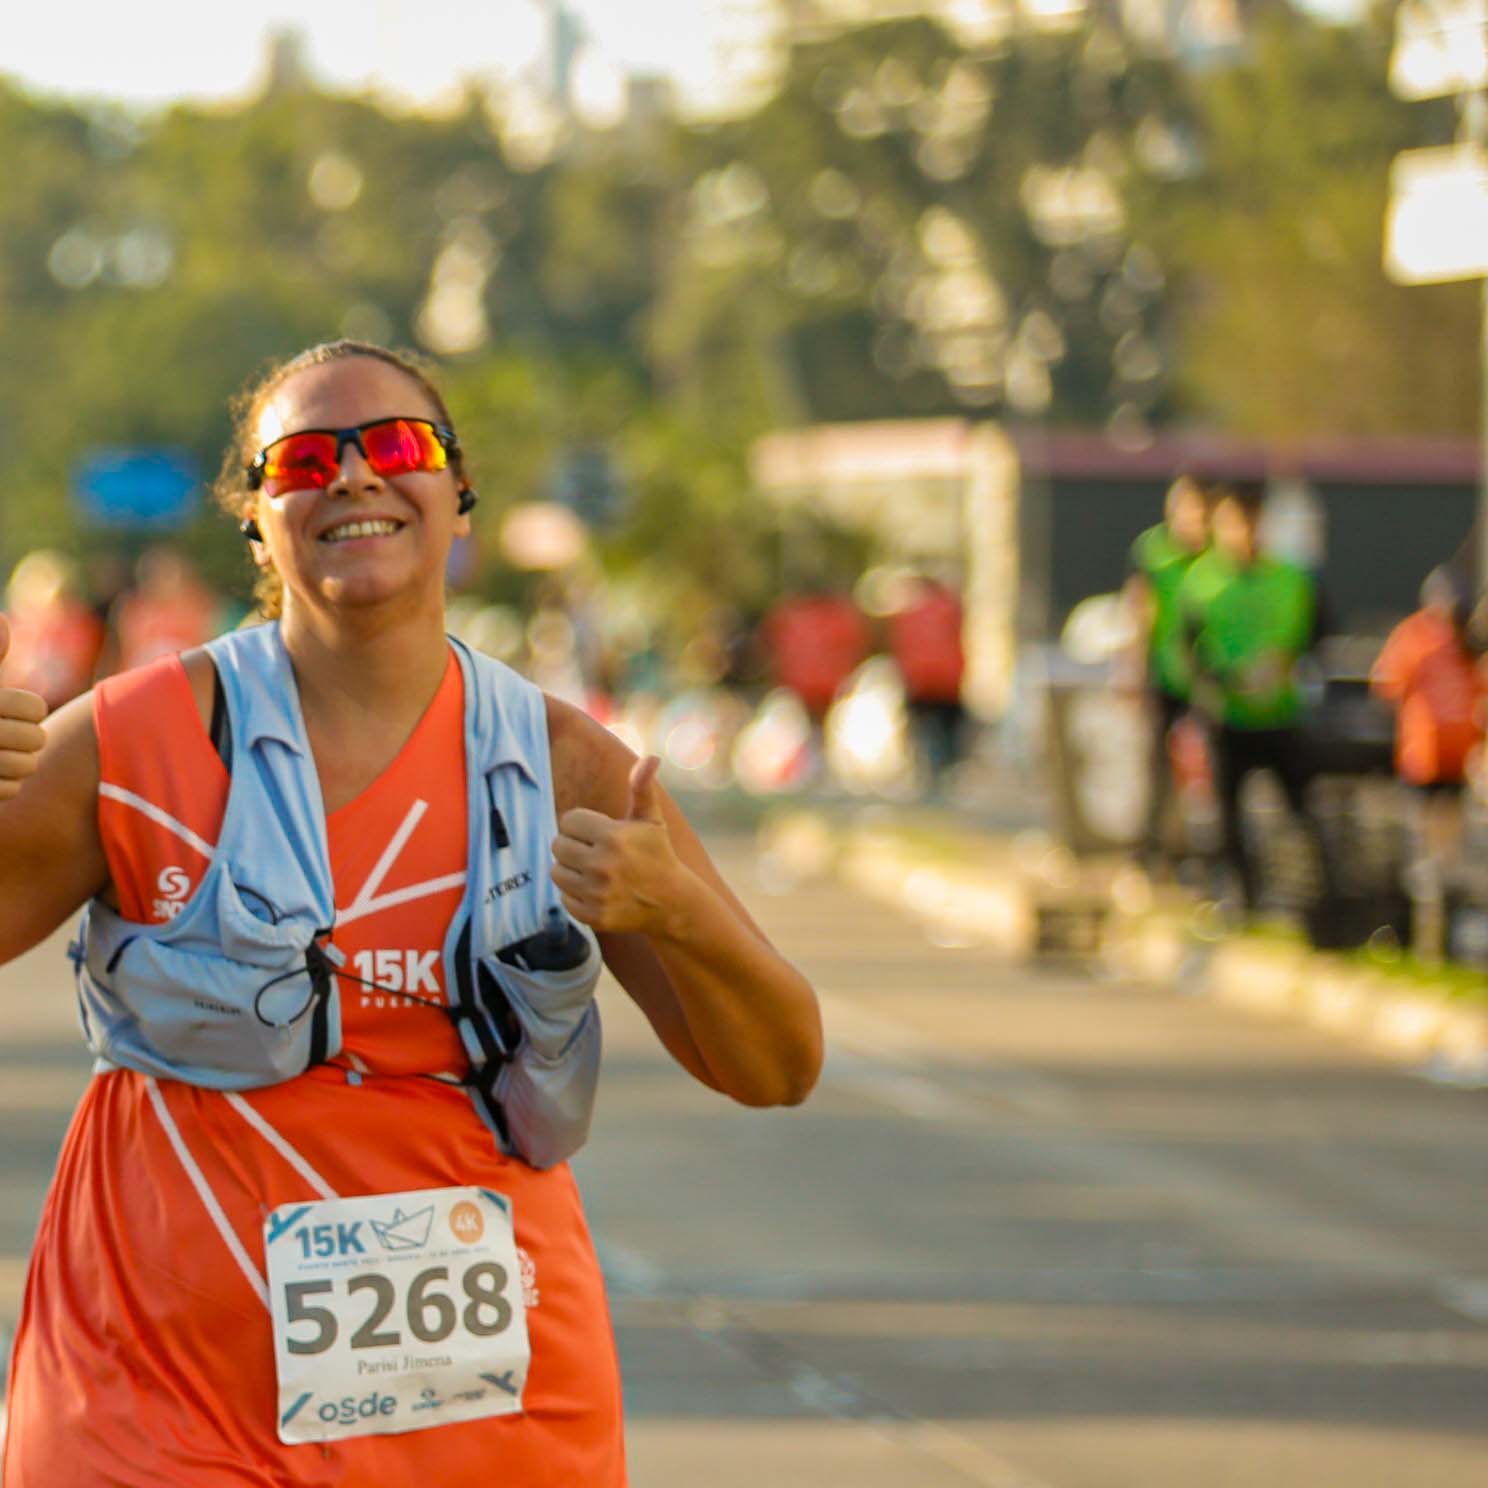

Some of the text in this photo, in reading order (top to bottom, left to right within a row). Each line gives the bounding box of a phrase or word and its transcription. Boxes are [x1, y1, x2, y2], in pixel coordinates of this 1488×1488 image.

[354, 949, 441, 993] 15K
[360, 995, 442, 1009] PUERO
[295, 1220, 366, 1259] 15K
[283, 1261, 513, 1356] 5268
[319, 1392, 397, 1425] osde
